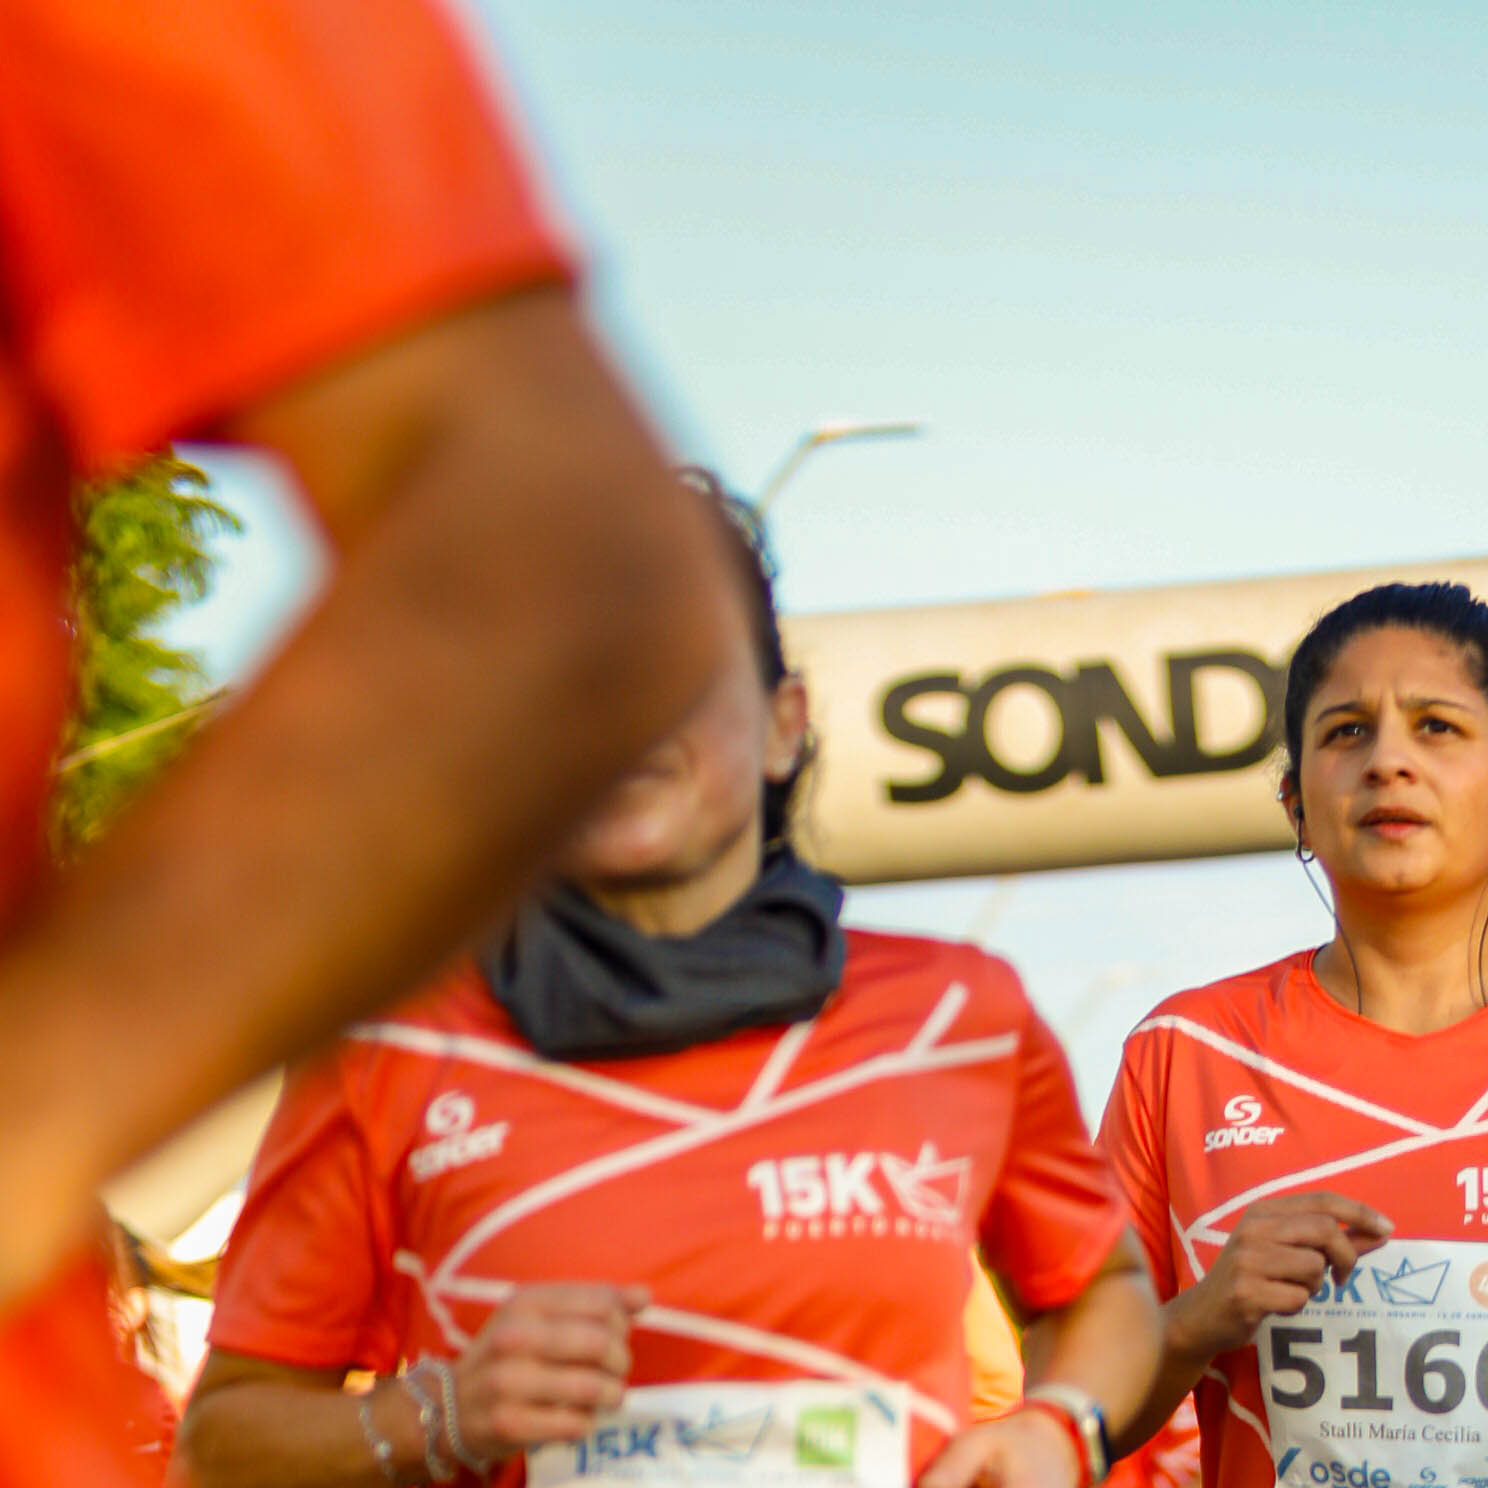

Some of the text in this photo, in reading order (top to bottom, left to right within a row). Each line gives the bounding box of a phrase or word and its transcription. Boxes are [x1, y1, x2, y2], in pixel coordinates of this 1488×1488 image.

[880, 647, 1289, 805] SOND
[746, 1151, 884, 1219] 15K
[1319, 1420, 1363, 1439] Stalli
[1421, 1424, 1481, 1443] Cecilia
